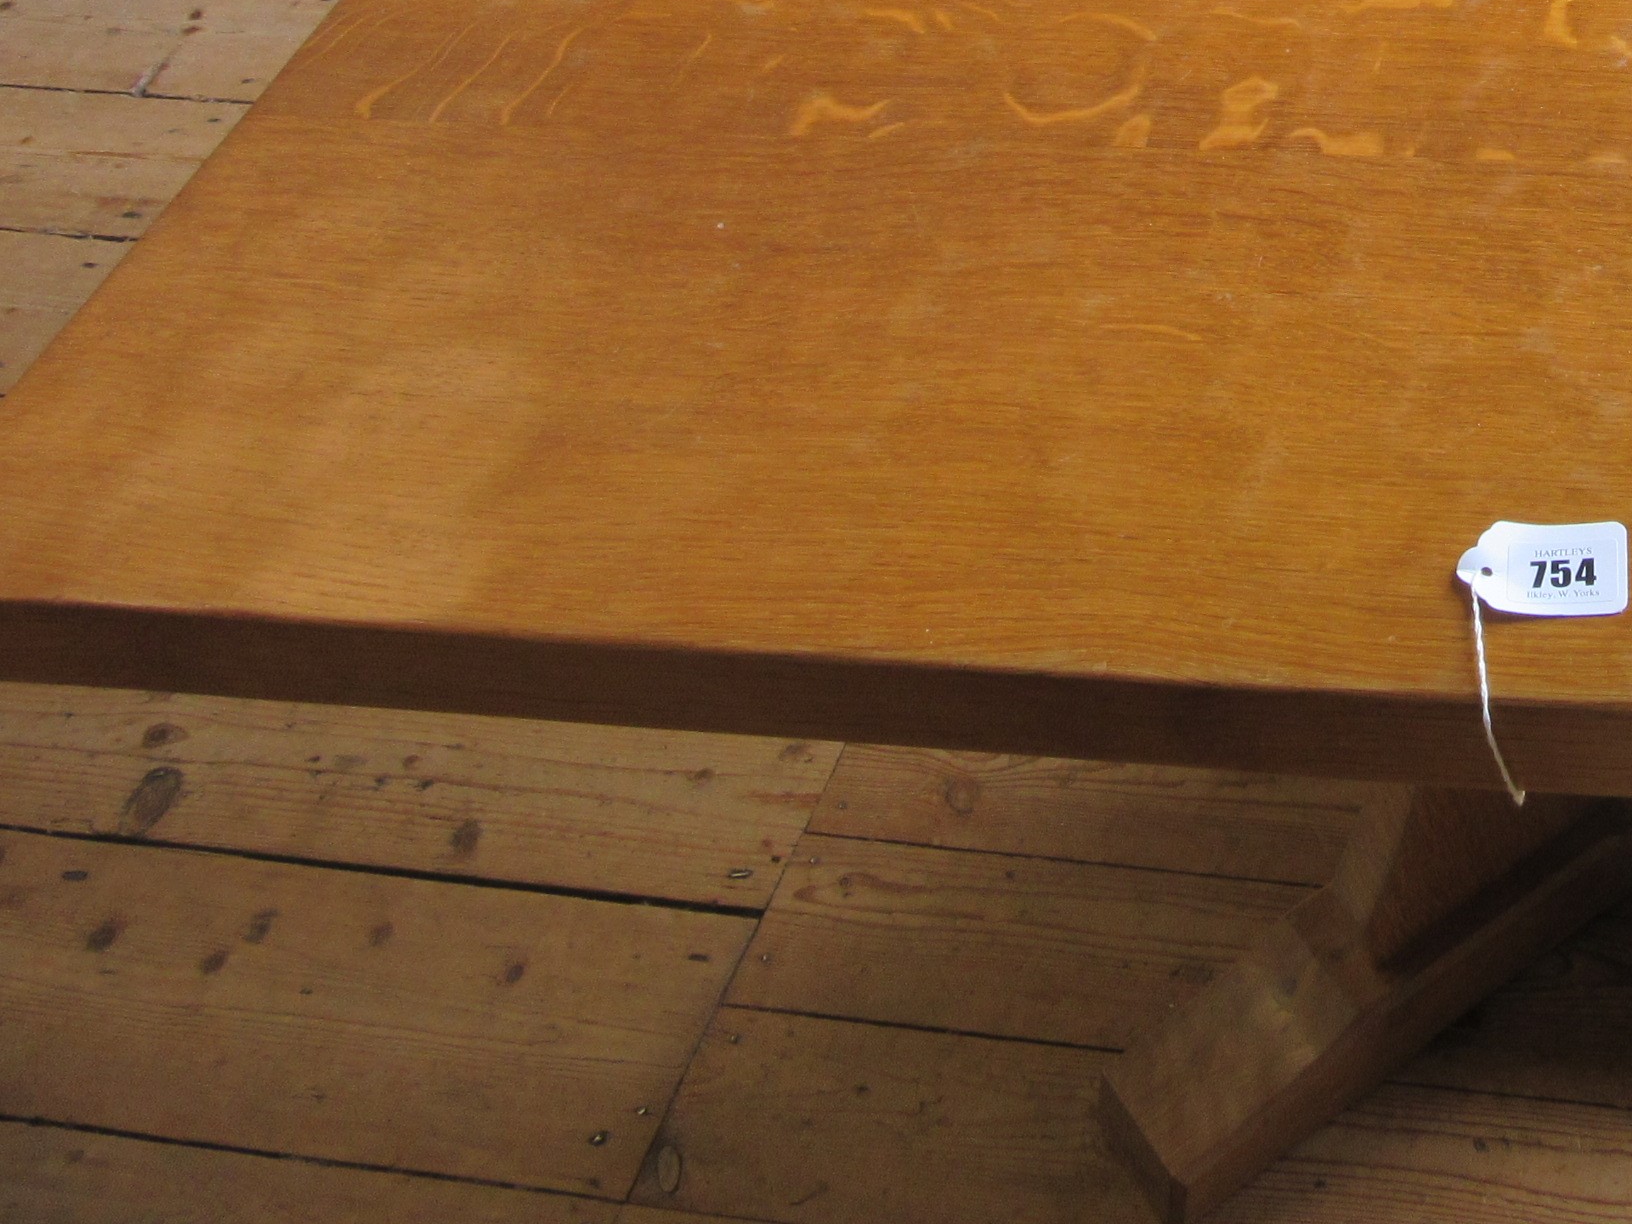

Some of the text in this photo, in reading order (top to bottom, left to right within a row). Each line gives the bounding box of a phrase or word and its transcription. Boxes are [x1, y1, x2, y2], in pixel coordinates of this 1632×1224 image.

[1534, 547, 1593, 557] HARTLEYS
[1530, 558, 1597, 588] 754
[1573, 589, 1600, 597] Yorks
